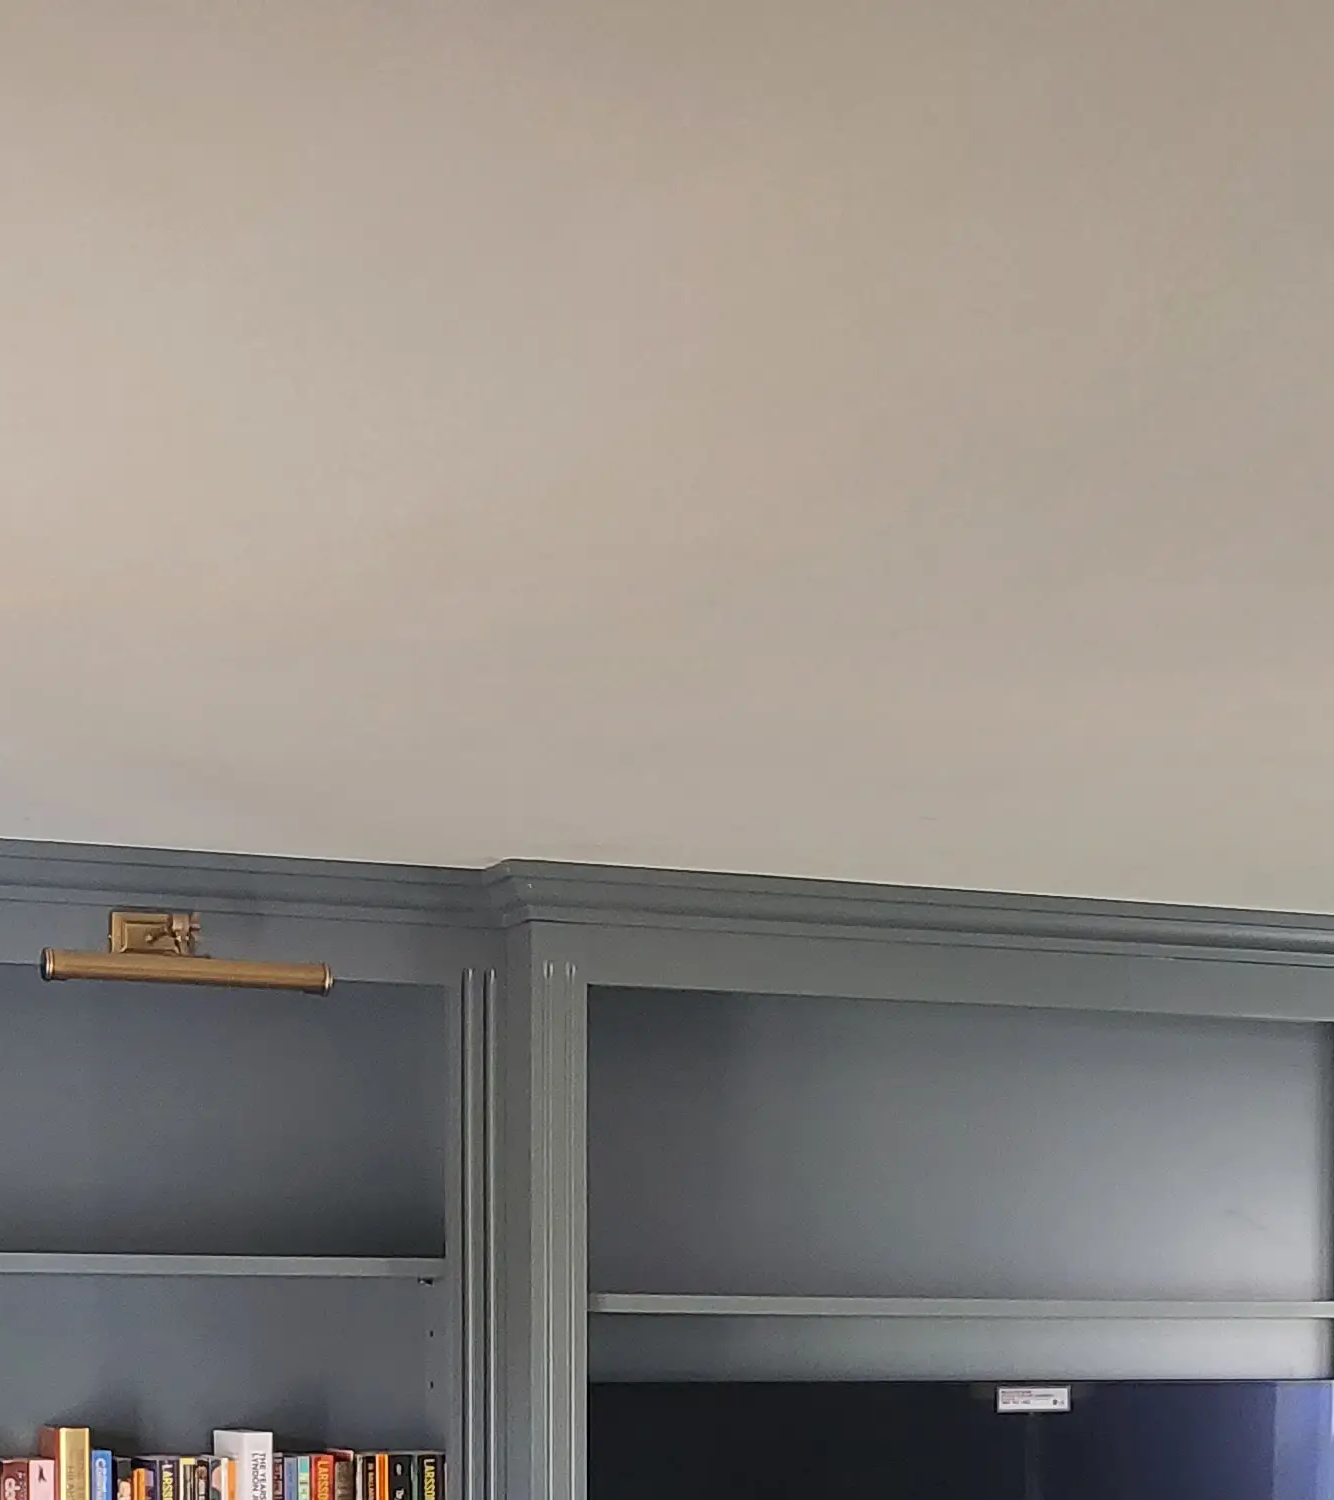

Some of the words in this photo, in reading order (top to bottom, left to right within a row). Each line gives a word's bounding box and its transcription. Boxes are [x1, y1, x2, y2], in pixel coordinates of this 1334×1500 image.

[251, 1452, 259, 1494] LYNDON
[259, 1452, 267, 1472] THE
[259, 1472, 267, 1500] YEARS
